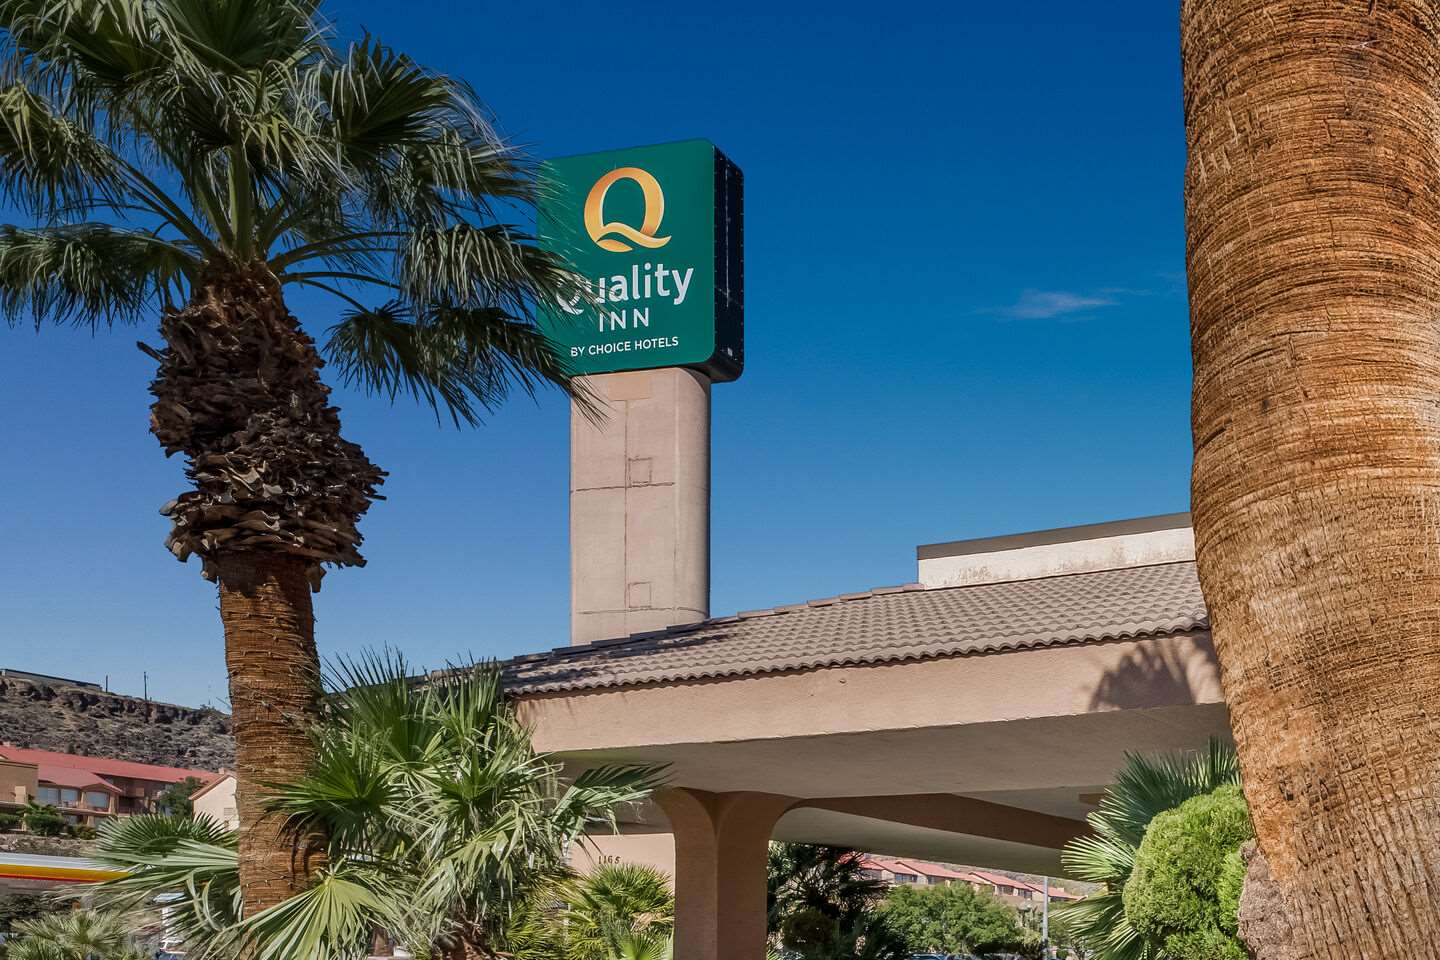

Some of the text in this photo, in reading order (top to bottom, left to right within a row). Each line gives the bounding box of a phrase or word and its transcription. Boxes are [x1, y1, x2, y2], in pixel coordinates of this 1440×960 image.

[584, 167, 672, 253] Q
[599, 307, 649, 333] INN
[570, 336, 679, 358] BY CHOICE HOTELS
[598, 855, 621, 865] 1165
